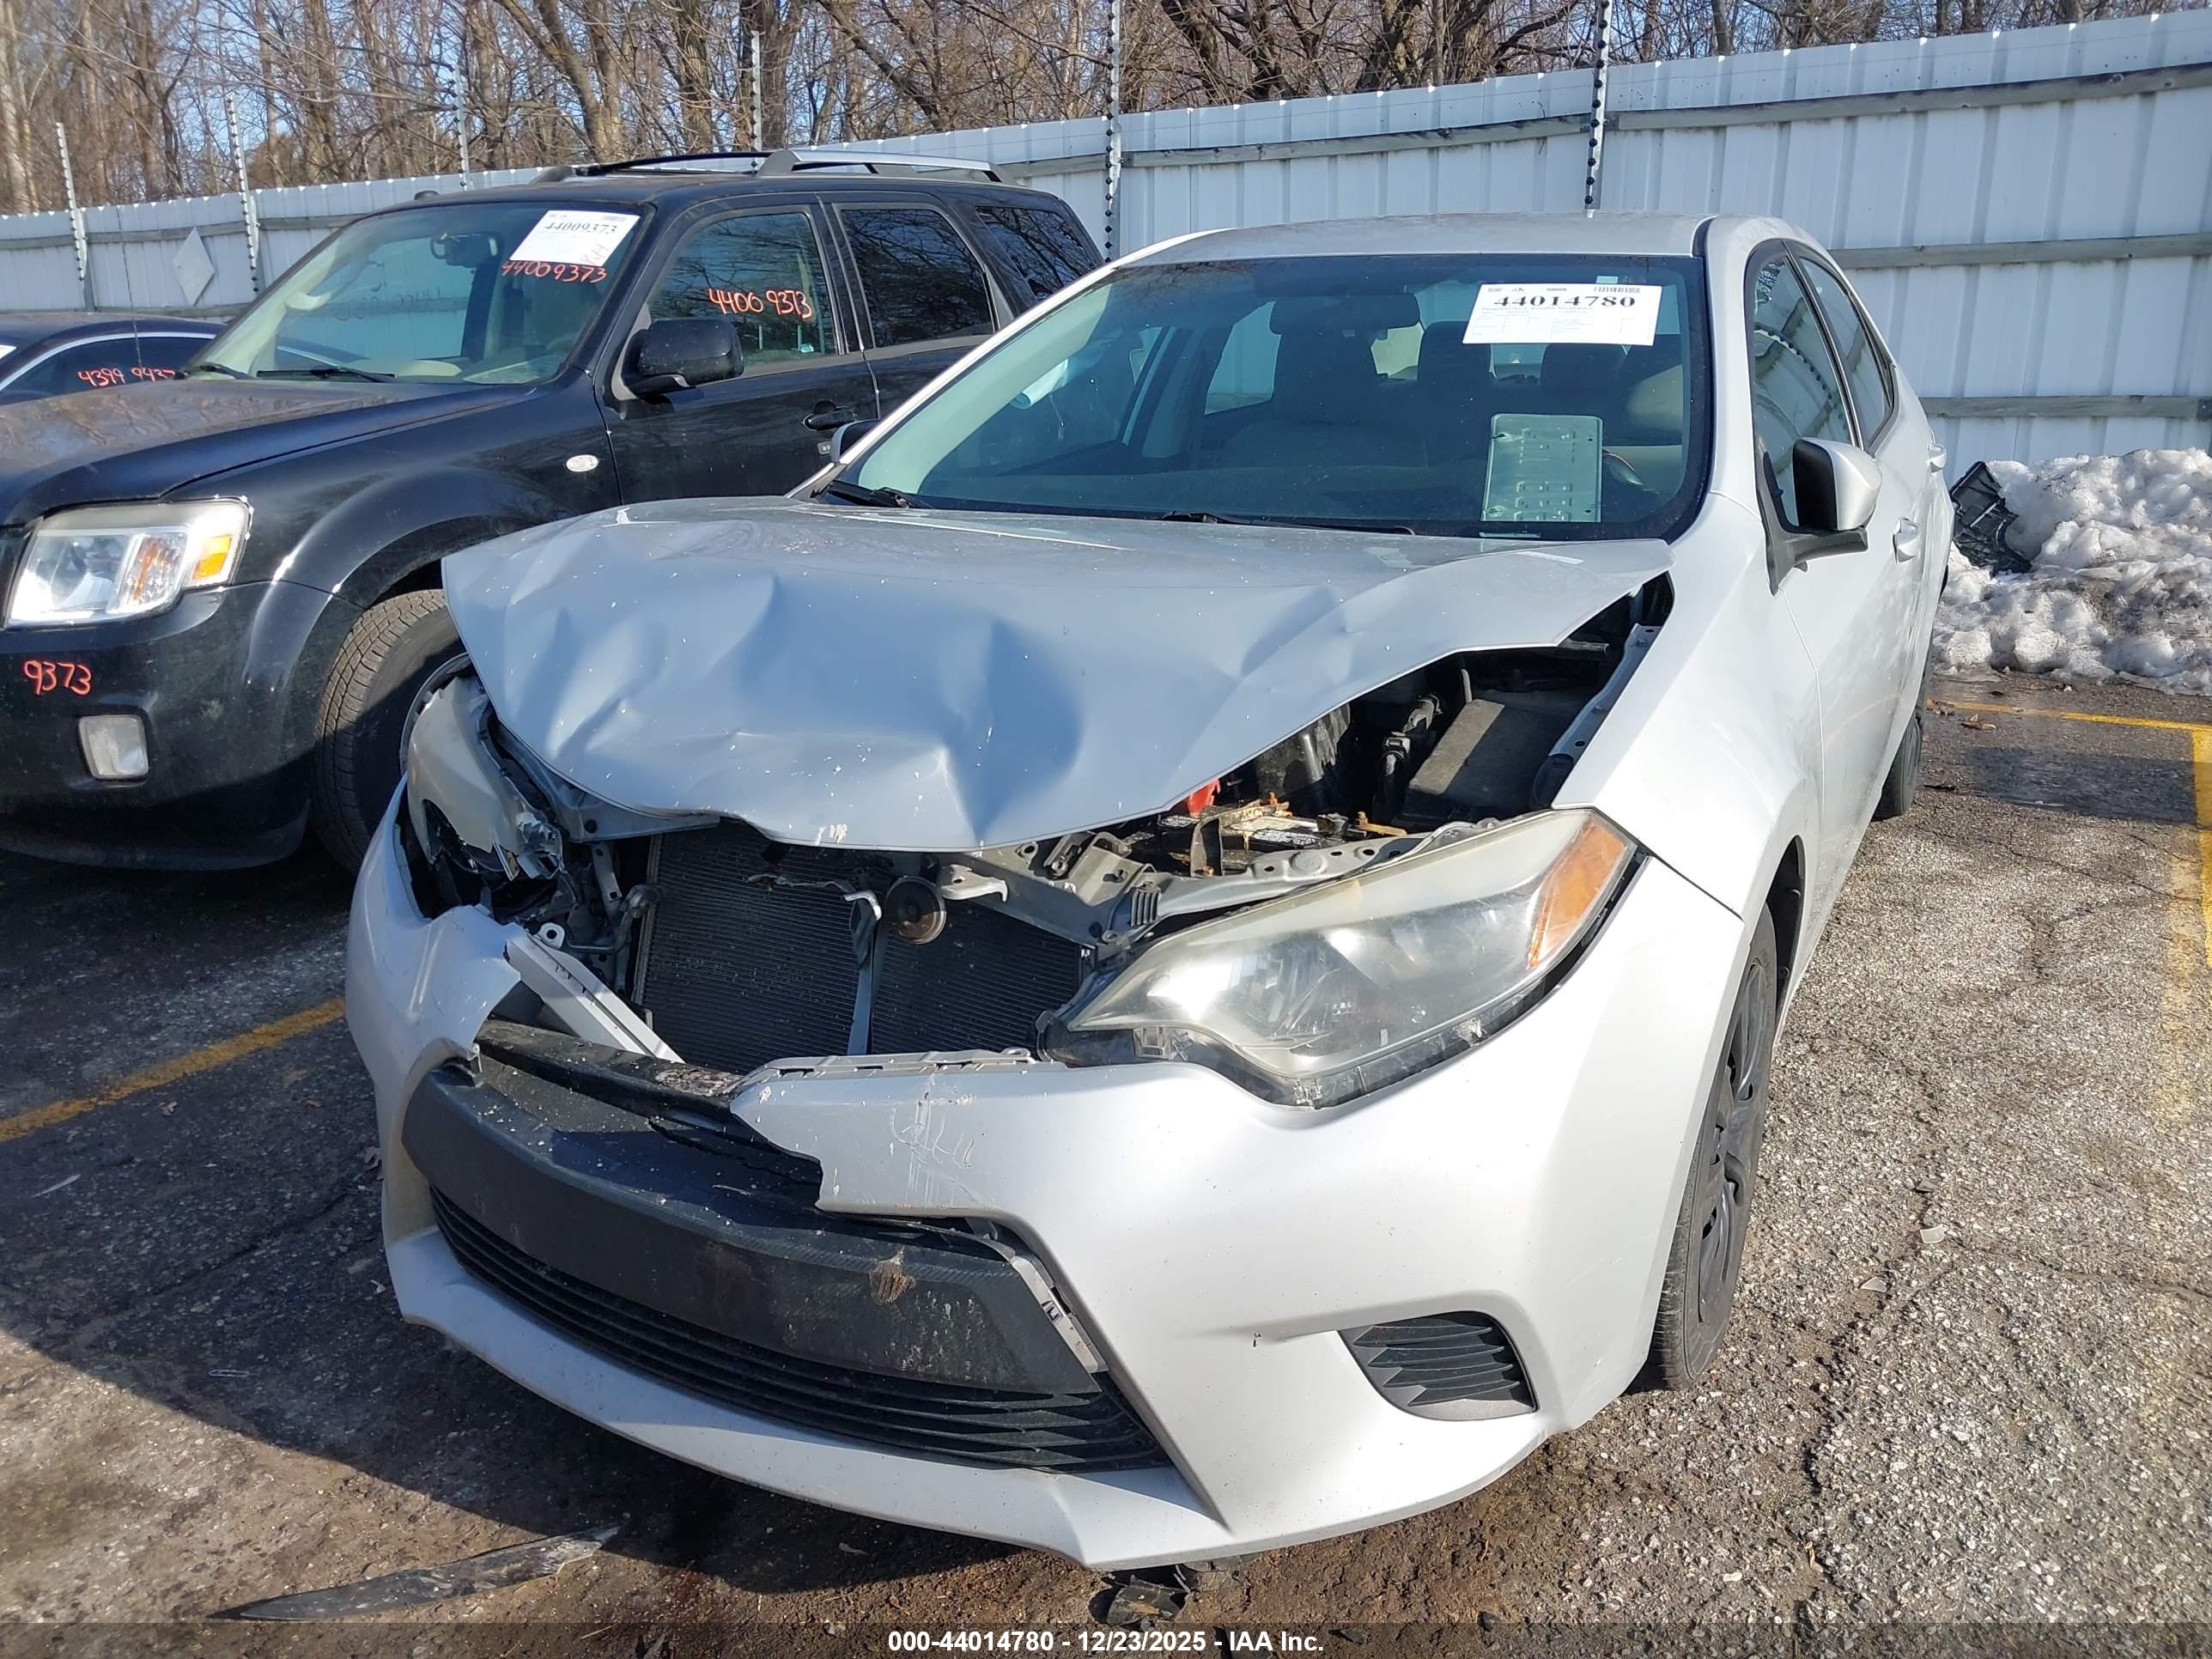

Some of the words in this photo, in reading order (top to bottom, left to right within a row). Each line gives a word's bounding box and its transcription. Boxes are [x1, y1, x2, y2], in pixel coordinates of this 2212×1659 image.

[544, 221, 618, 234] 44009373
[501, 260, 607, 283] 44009373
[708, 288, 763, 315] 4400
[766, 289, 812, 319] 9373
[1493, 295, 1636, 307] 44014780
[77, 367, 126, 386] 4399
[24, 659, 92, 696] 9373
